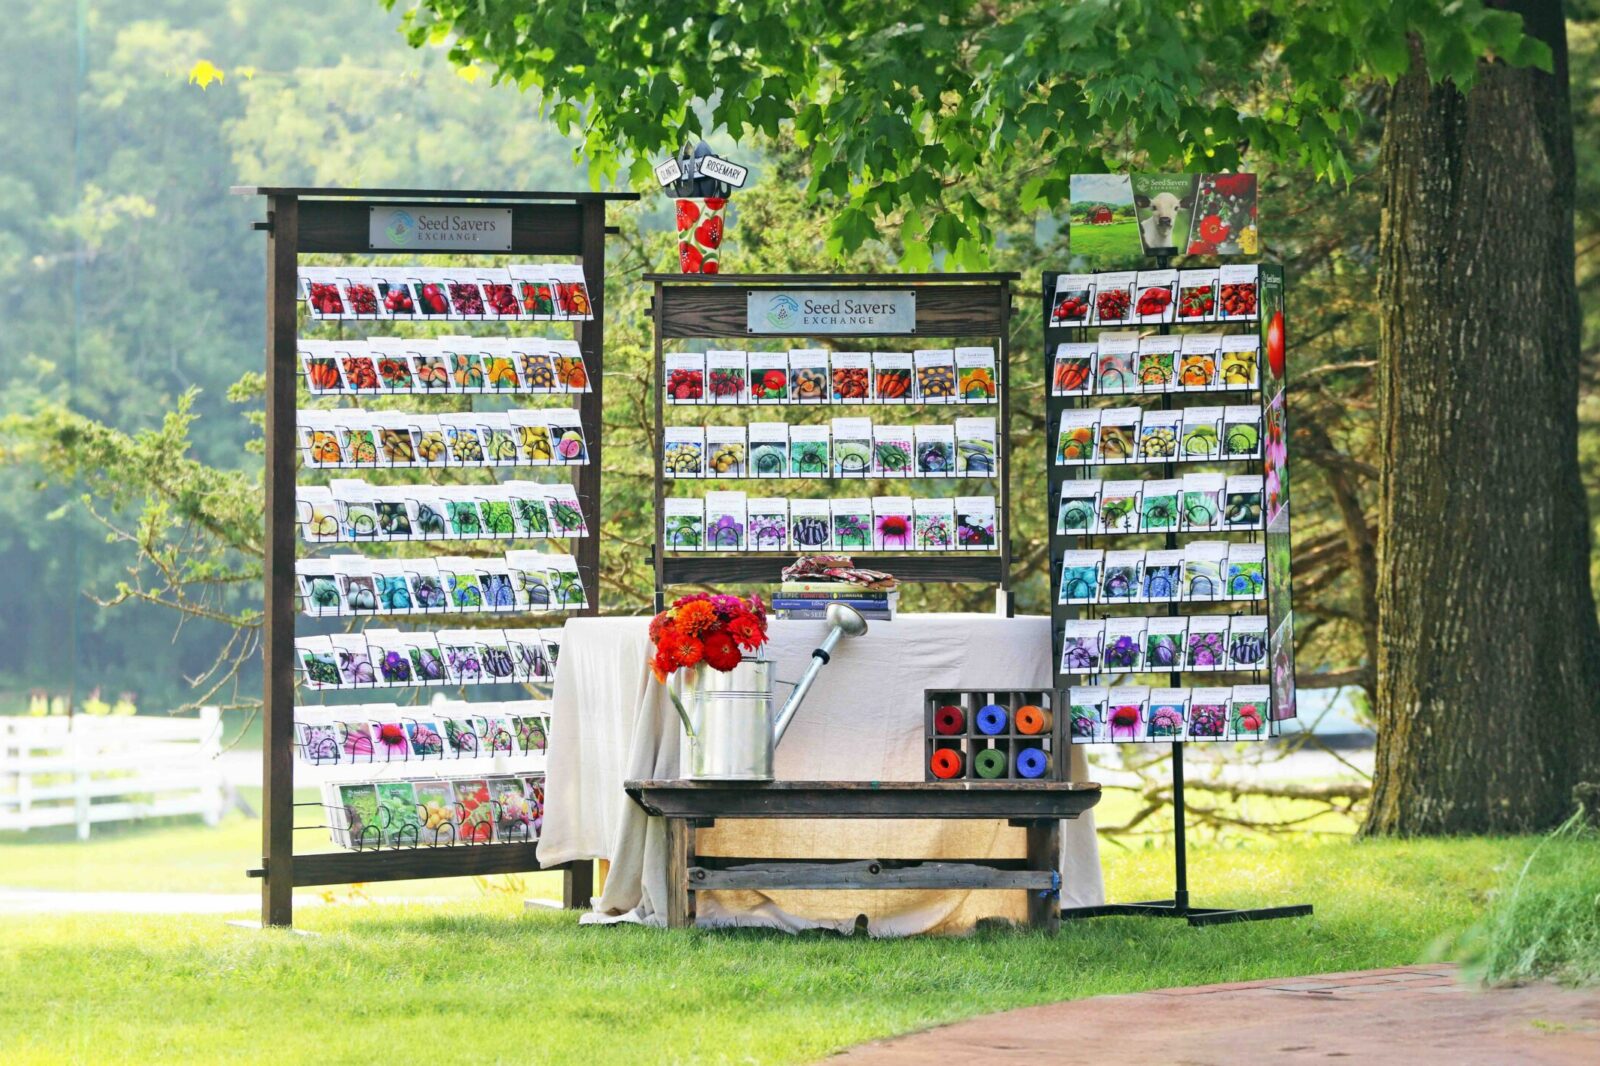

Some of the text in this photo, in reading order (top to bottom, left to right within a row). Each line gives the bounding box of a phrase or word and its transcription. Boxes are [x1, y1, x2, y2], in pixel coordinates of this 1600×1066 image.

[706, 159, 741, 180] ROSEMARY
[418, 215, 496, 231] Seed Savers
[418, 233, 478, 241] EXCHANGE
[804, 299, 896, 315] Seed Savers
[803, 316, 875, 325] EXCHANGE
